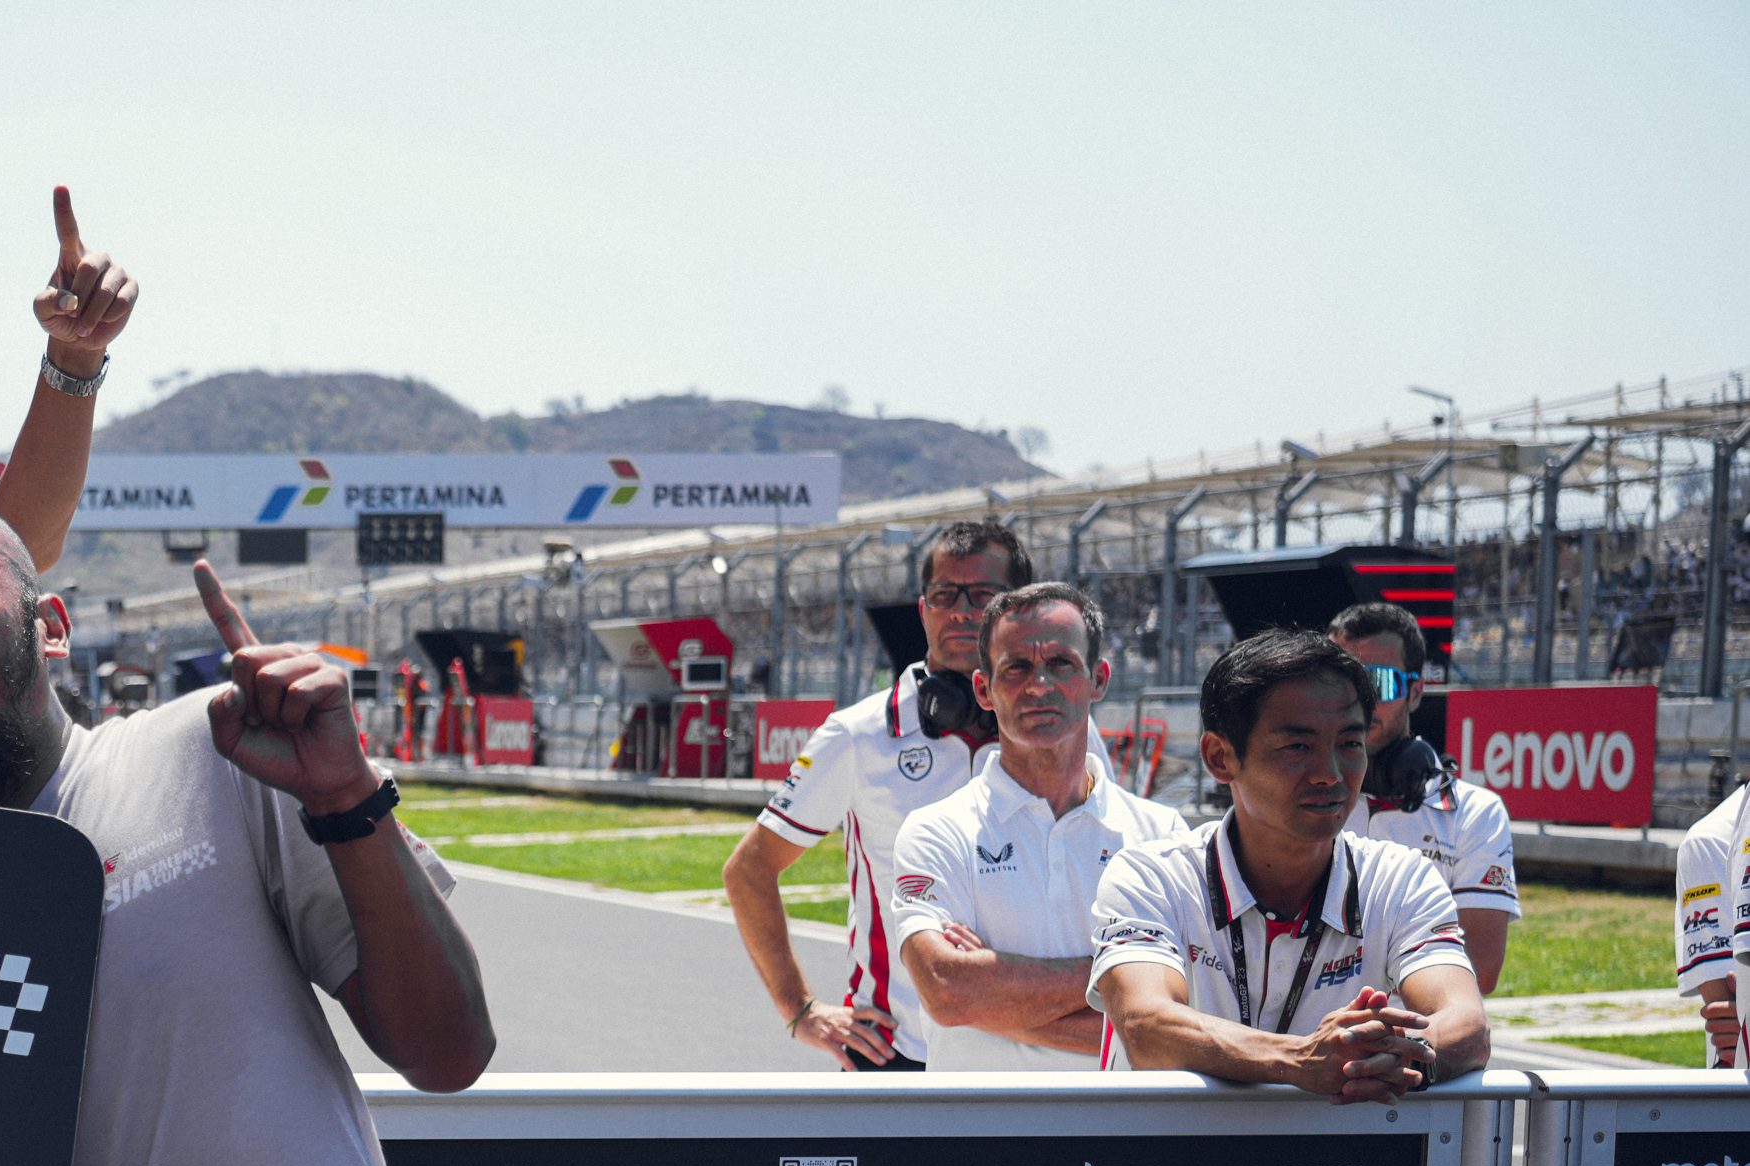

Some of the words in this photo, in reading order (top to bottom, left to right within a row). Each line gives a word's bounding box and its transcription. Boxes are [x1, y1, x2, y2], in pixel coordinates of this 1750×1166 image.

[77, 487, 194, 510] TAMINA
[345, 485, 506, 508] PERTAMINA
[653, 483, 811, 507] PERTAMINA
[759, 718, 817, 764] Leno
[1461, 717, 1635, 792] Lenovo
[124, 827, 184, 864] idemitsu
[151, 842, 202, 876] TALENT
[153, 866, 182, 888] CUP
[979, 866, 1018, 875] CASTORE
[102, 869, 153, 917] SIA
